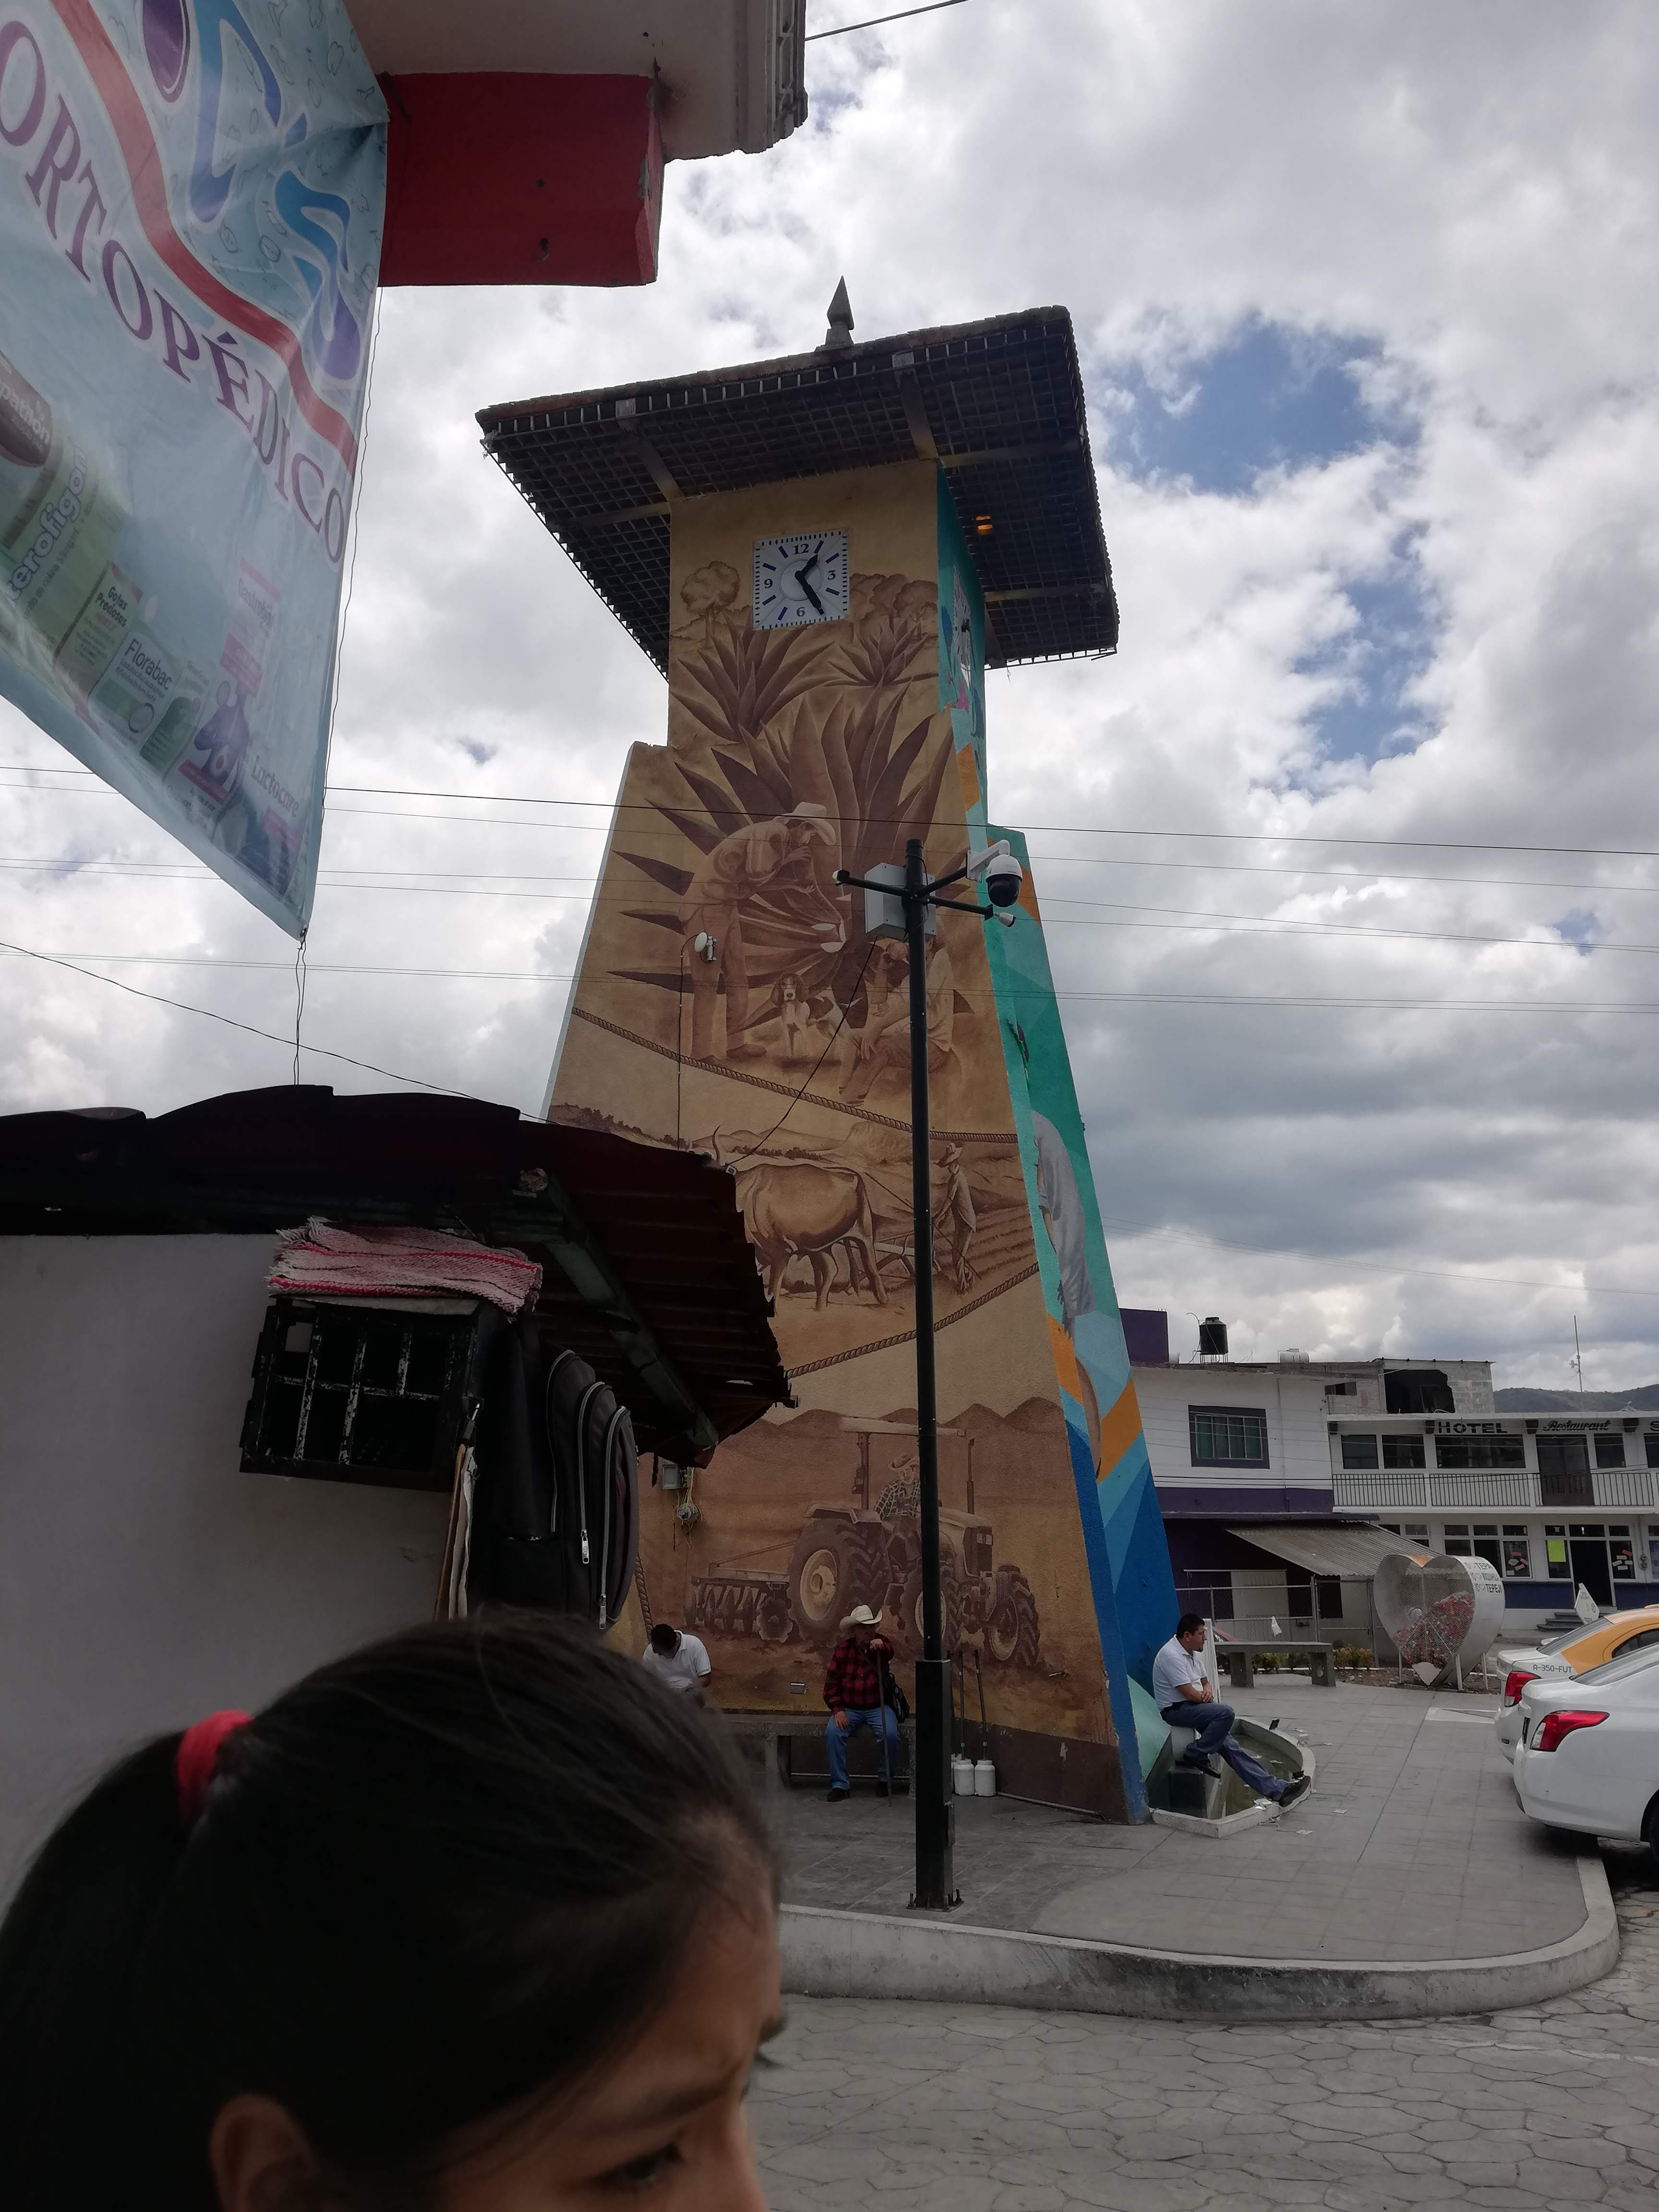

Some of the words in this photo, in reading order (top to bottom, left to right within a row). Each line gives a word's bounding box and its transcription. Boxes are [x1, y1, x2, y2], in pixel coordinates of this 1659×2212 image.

[0, 21, 344, 563] ORTOPÉDICO
[793, 543, 809, 554] 12
[828, 570, 836, 580] 3
[764, 578, 773, 589] 9
[108, 586, 128, 611] Gotas
[96, 592, 127, 627] Preciosas
[796, 607, 805, 617] 6
[124, 638, 172, 690] Florabac
[1438, 1421, 1508, 1433] HOTEL
[1543, 1420, 1611, 1431] Restaurant
[1533, 1664, 1573, 1673] A-350-FUT
